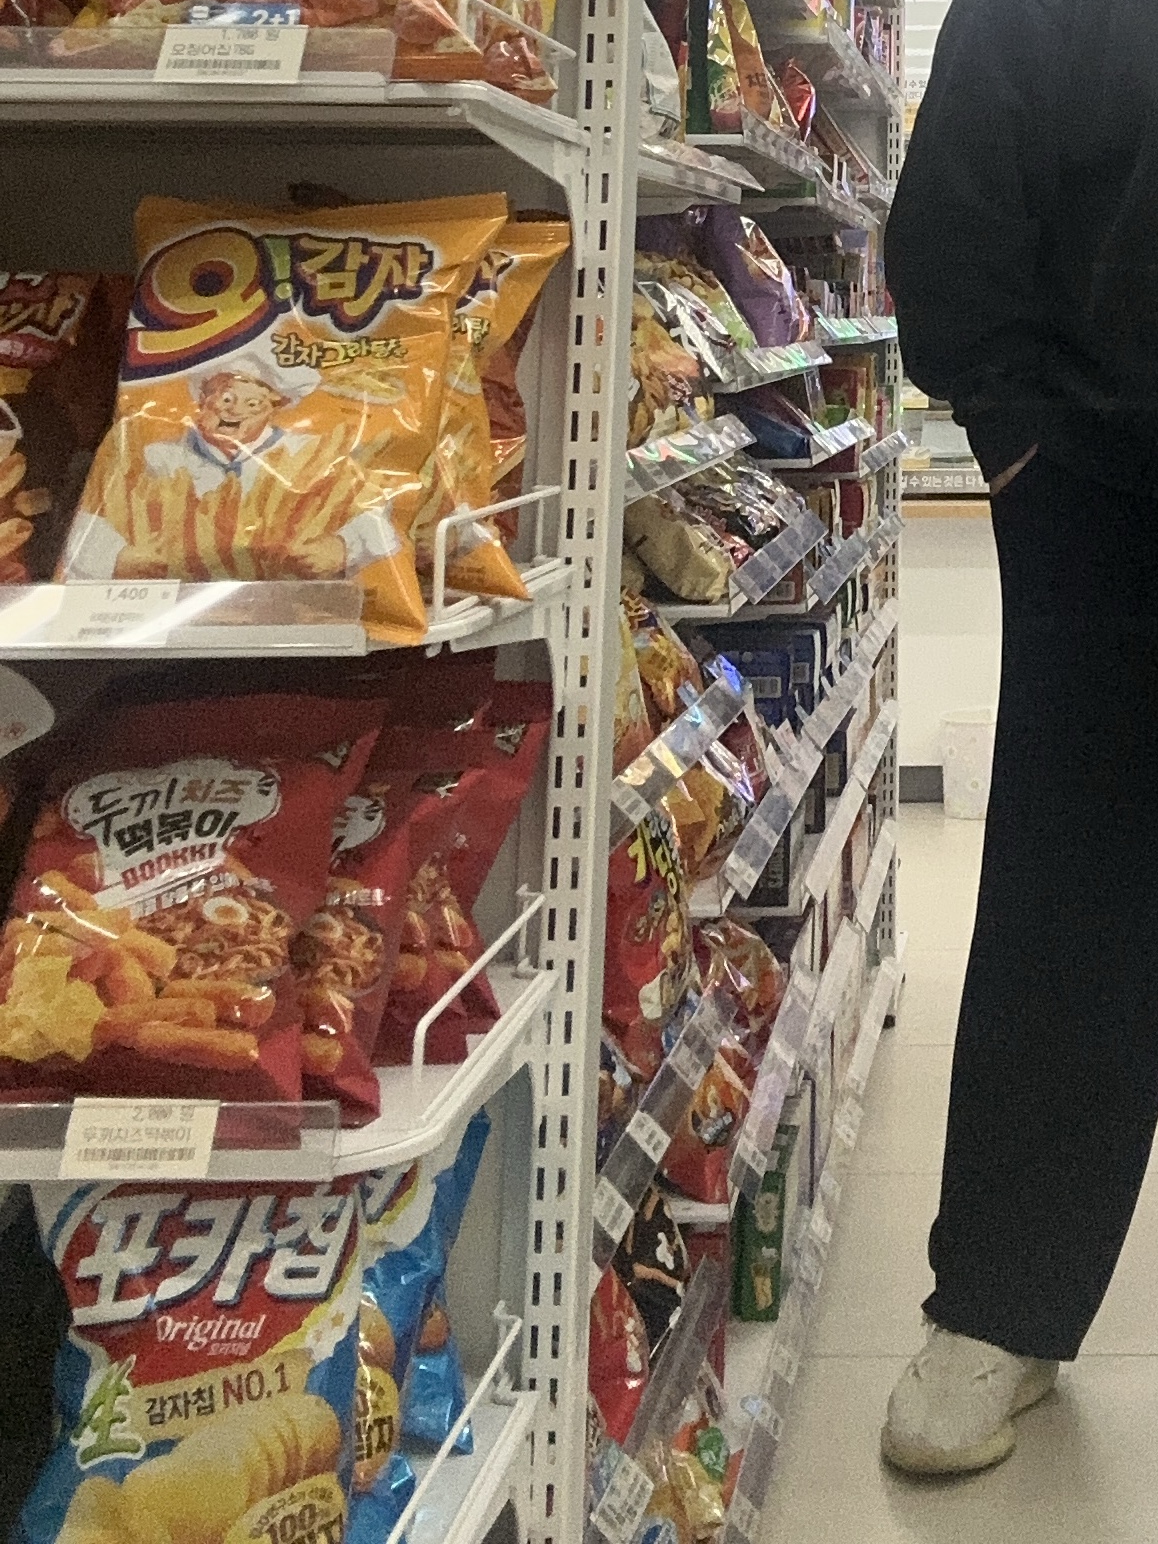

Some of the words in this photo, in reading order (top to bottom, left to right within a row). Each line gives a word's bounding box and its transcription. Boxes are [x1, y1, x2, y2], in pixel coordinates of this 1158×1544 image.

[252, 8, 300, 25] 2+1
[126, 227, 431, 361] 오!감자
[113, 808, 240, 858] 떡볶이
[121, 842, 218, 881] DOOKKI
[72, 1179, 358, 1328] 포카칩
[156, 1314, 266, 1350] Original
[145, 1384, 215, 1426] 감자칩
[222, 1362, 291, 1409] NO.1
